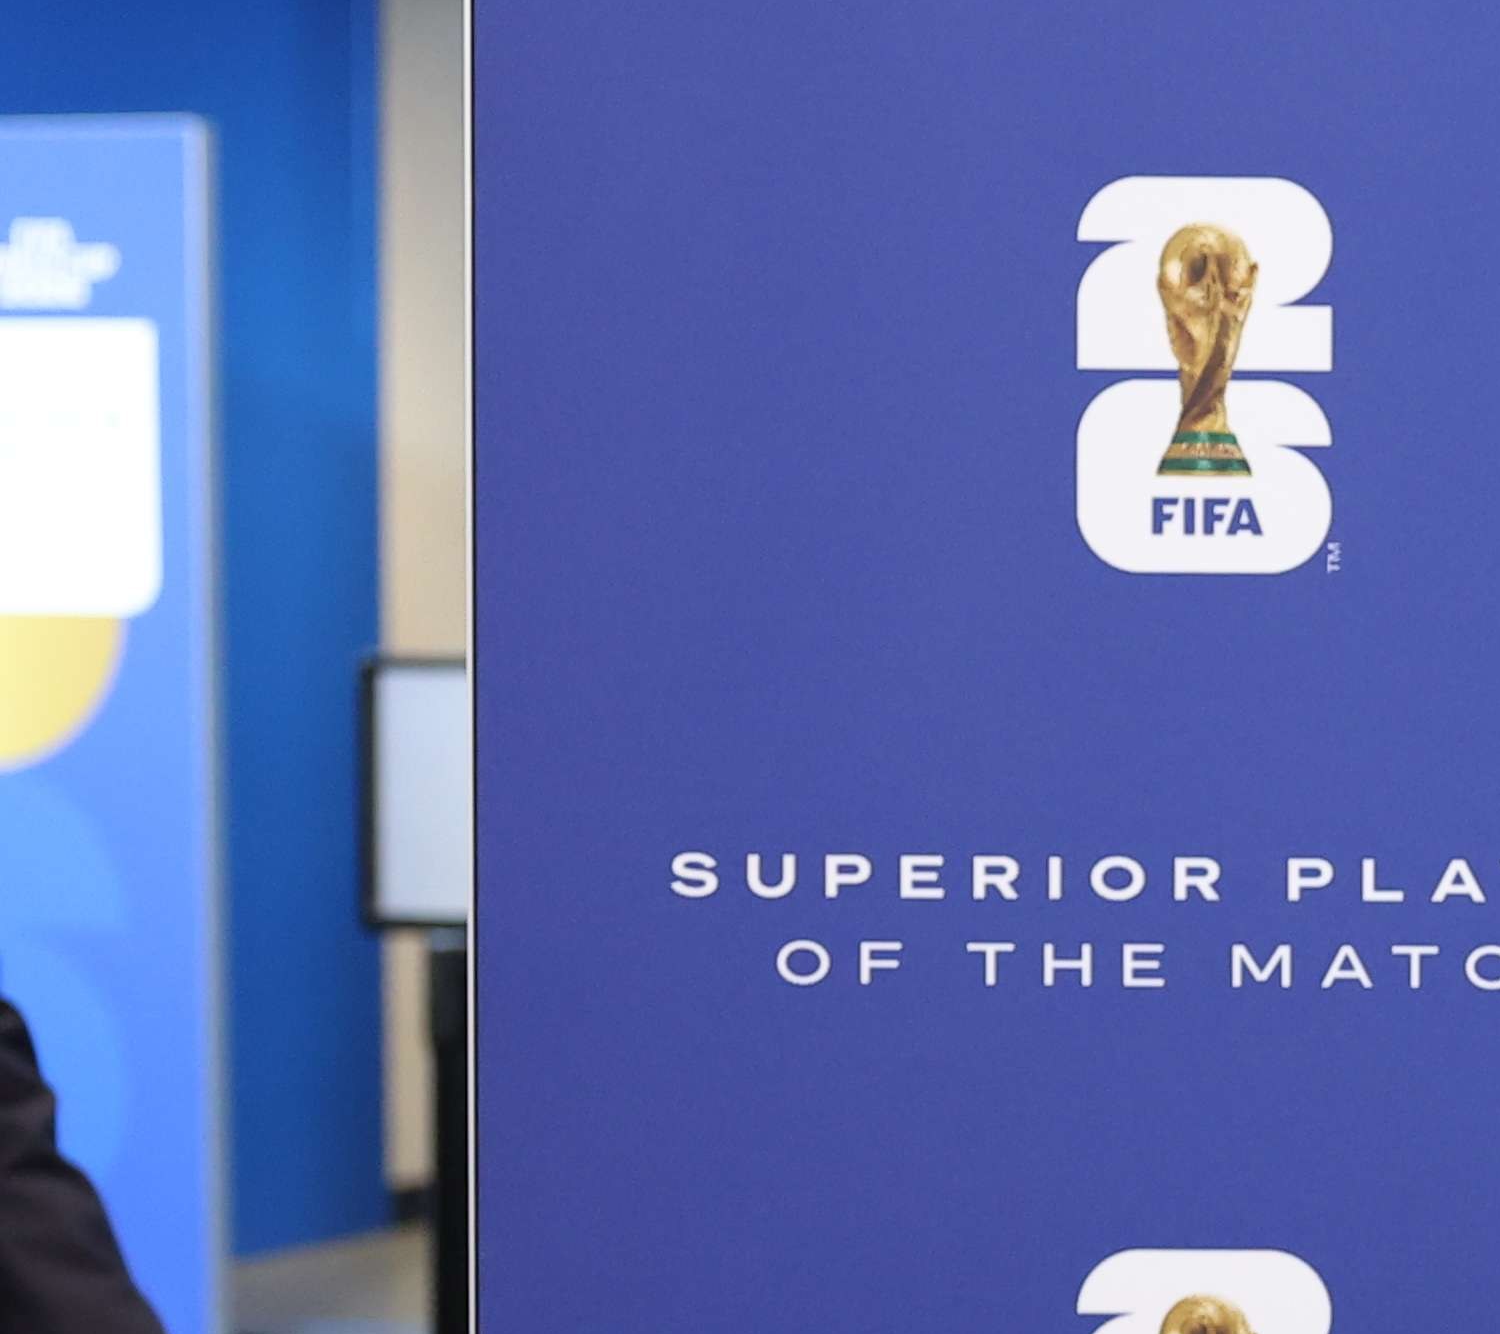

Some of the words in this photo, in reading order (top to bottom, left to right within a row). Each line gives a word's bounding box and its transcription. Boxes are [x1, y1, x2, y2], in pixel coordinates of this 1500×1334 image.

[1152, 497, 1262, 535] FIFA
[670, 851, 1221, 902] SUPERIOR
[776, 939, 903, 986] OF
[966, 942, 1166, 988] THE
